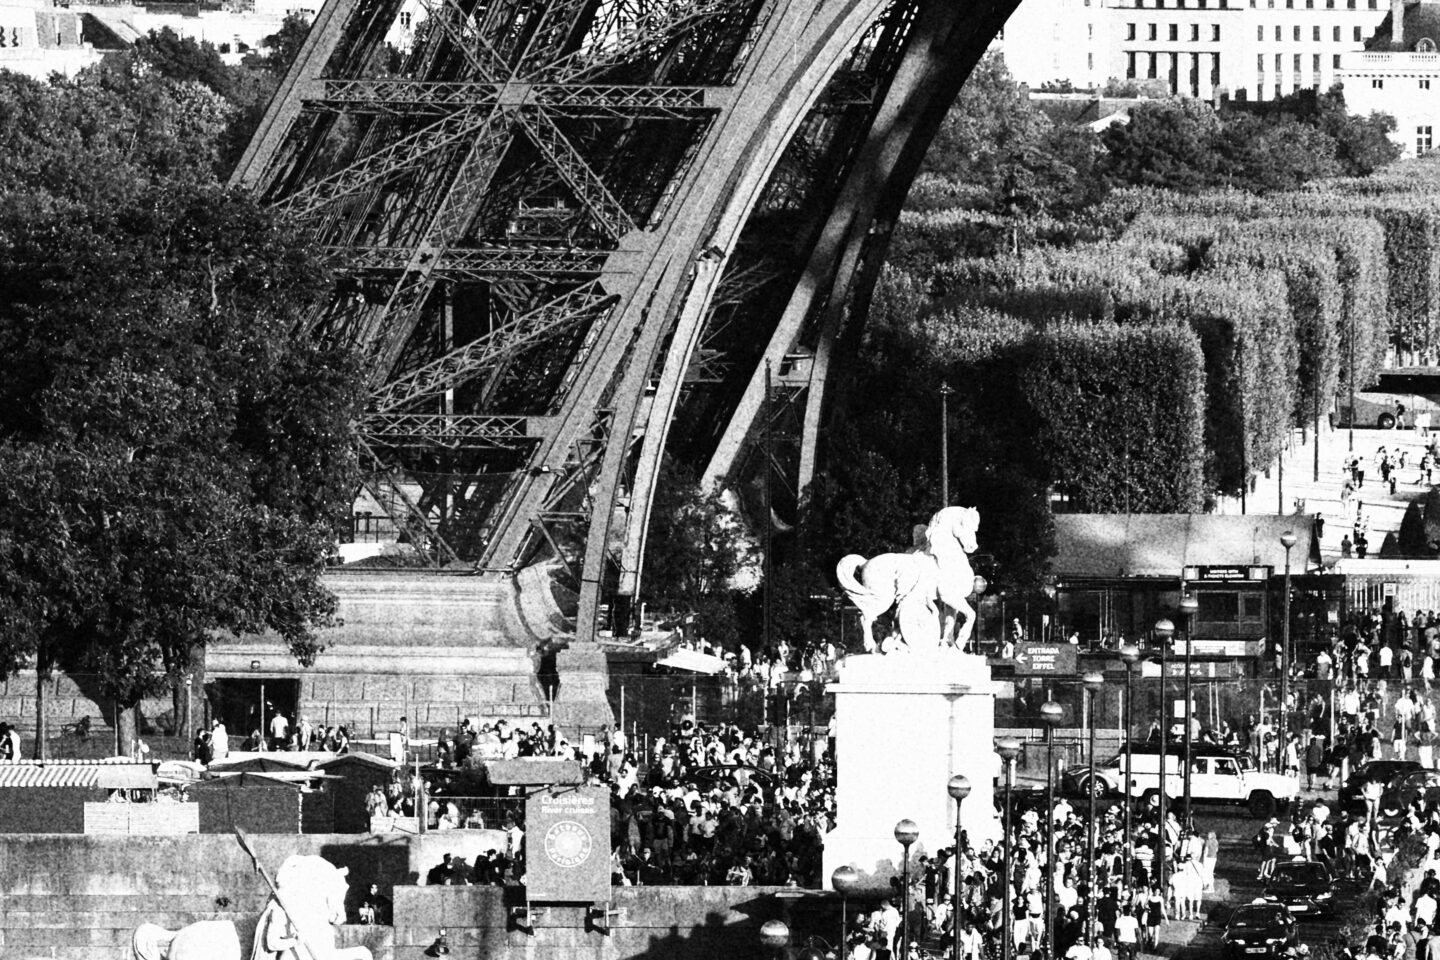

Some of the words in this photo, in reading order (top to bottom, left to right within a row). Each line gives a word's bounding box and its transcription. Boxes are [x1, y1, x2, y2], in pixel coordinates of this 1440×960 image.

[1027, 647, 1060, 655] ENTRADA
[1032, 662, 1056, 670] EIFFEL
[541, 794, 595, 805] Croisières
[541, 805, 562, 814] River
